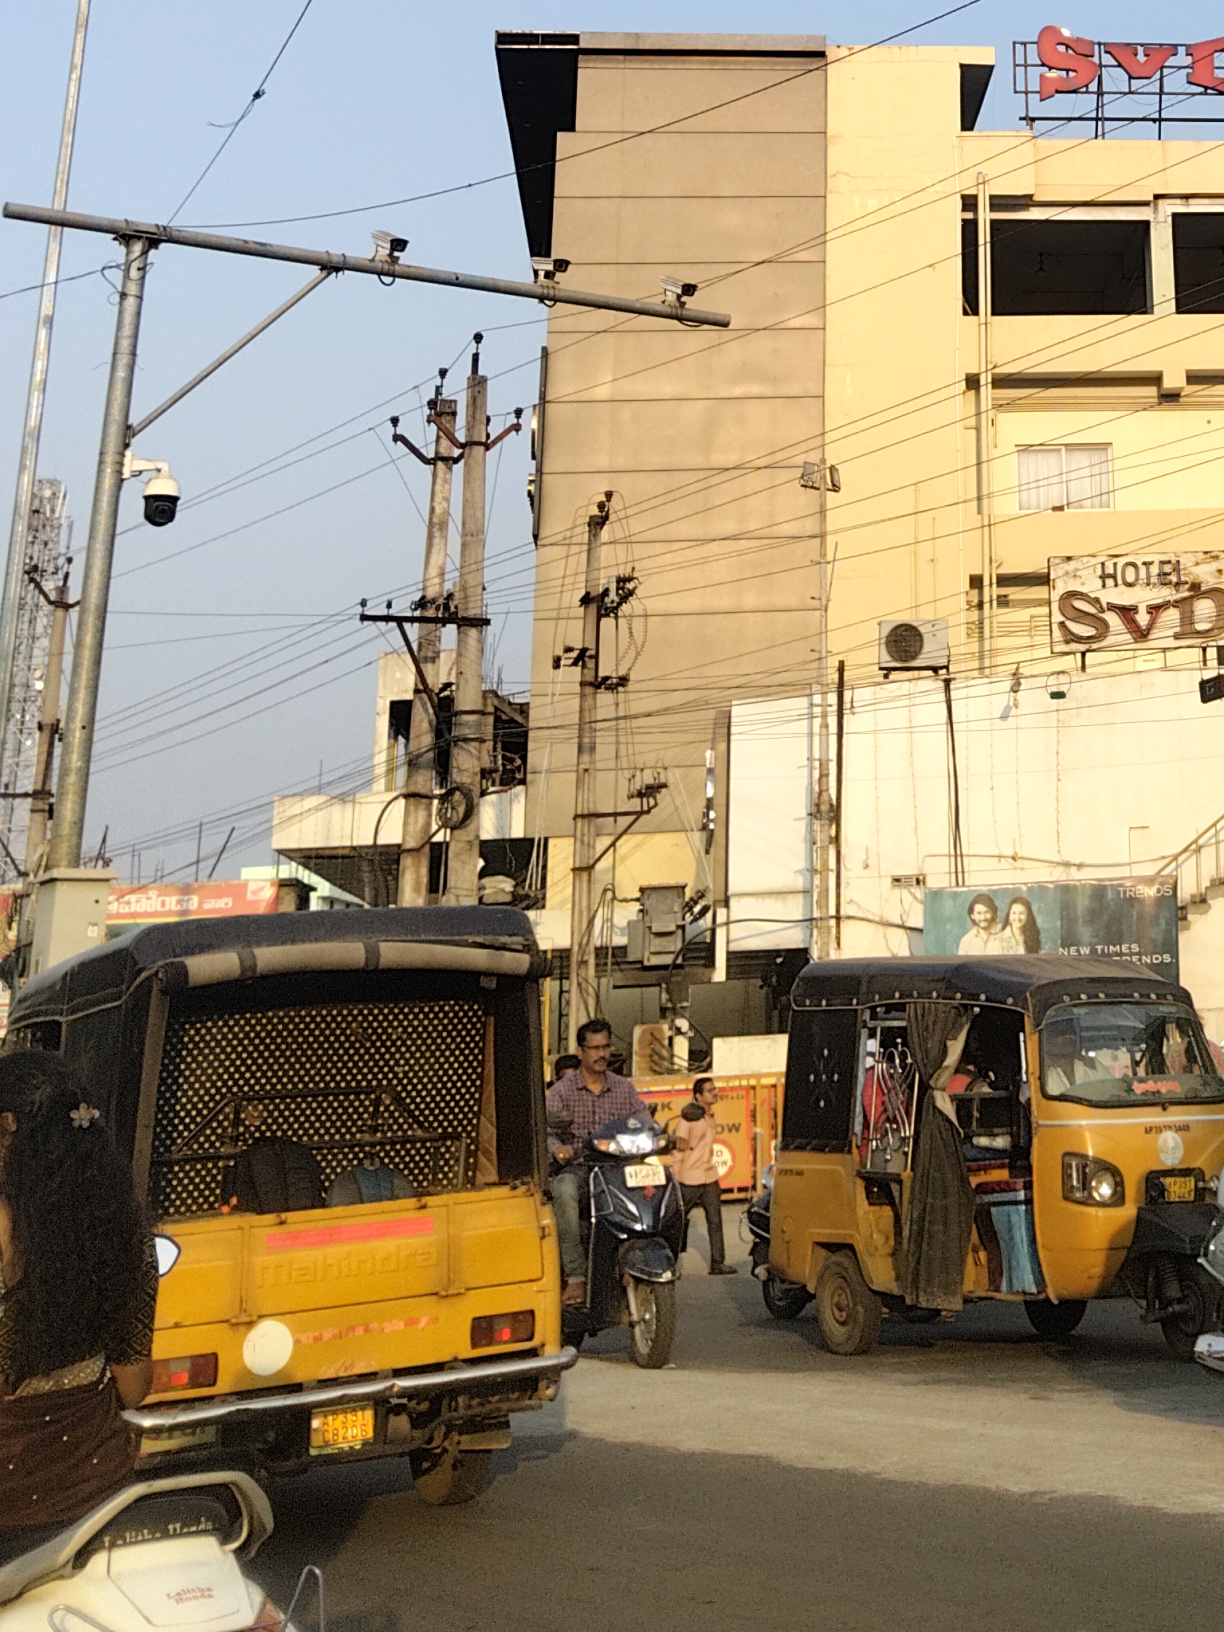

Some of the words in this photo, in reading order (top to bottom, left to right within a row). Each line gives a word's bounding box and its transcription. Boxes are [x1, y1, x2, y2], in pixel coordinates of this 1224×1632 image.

[1099, 560, 1188, 588] HOTEL
[1118, 885, 1173, 898] TRENDS
[1059, 946, 1090, 956] NEW
[1095, 943, 1144, 954] TIMES.
